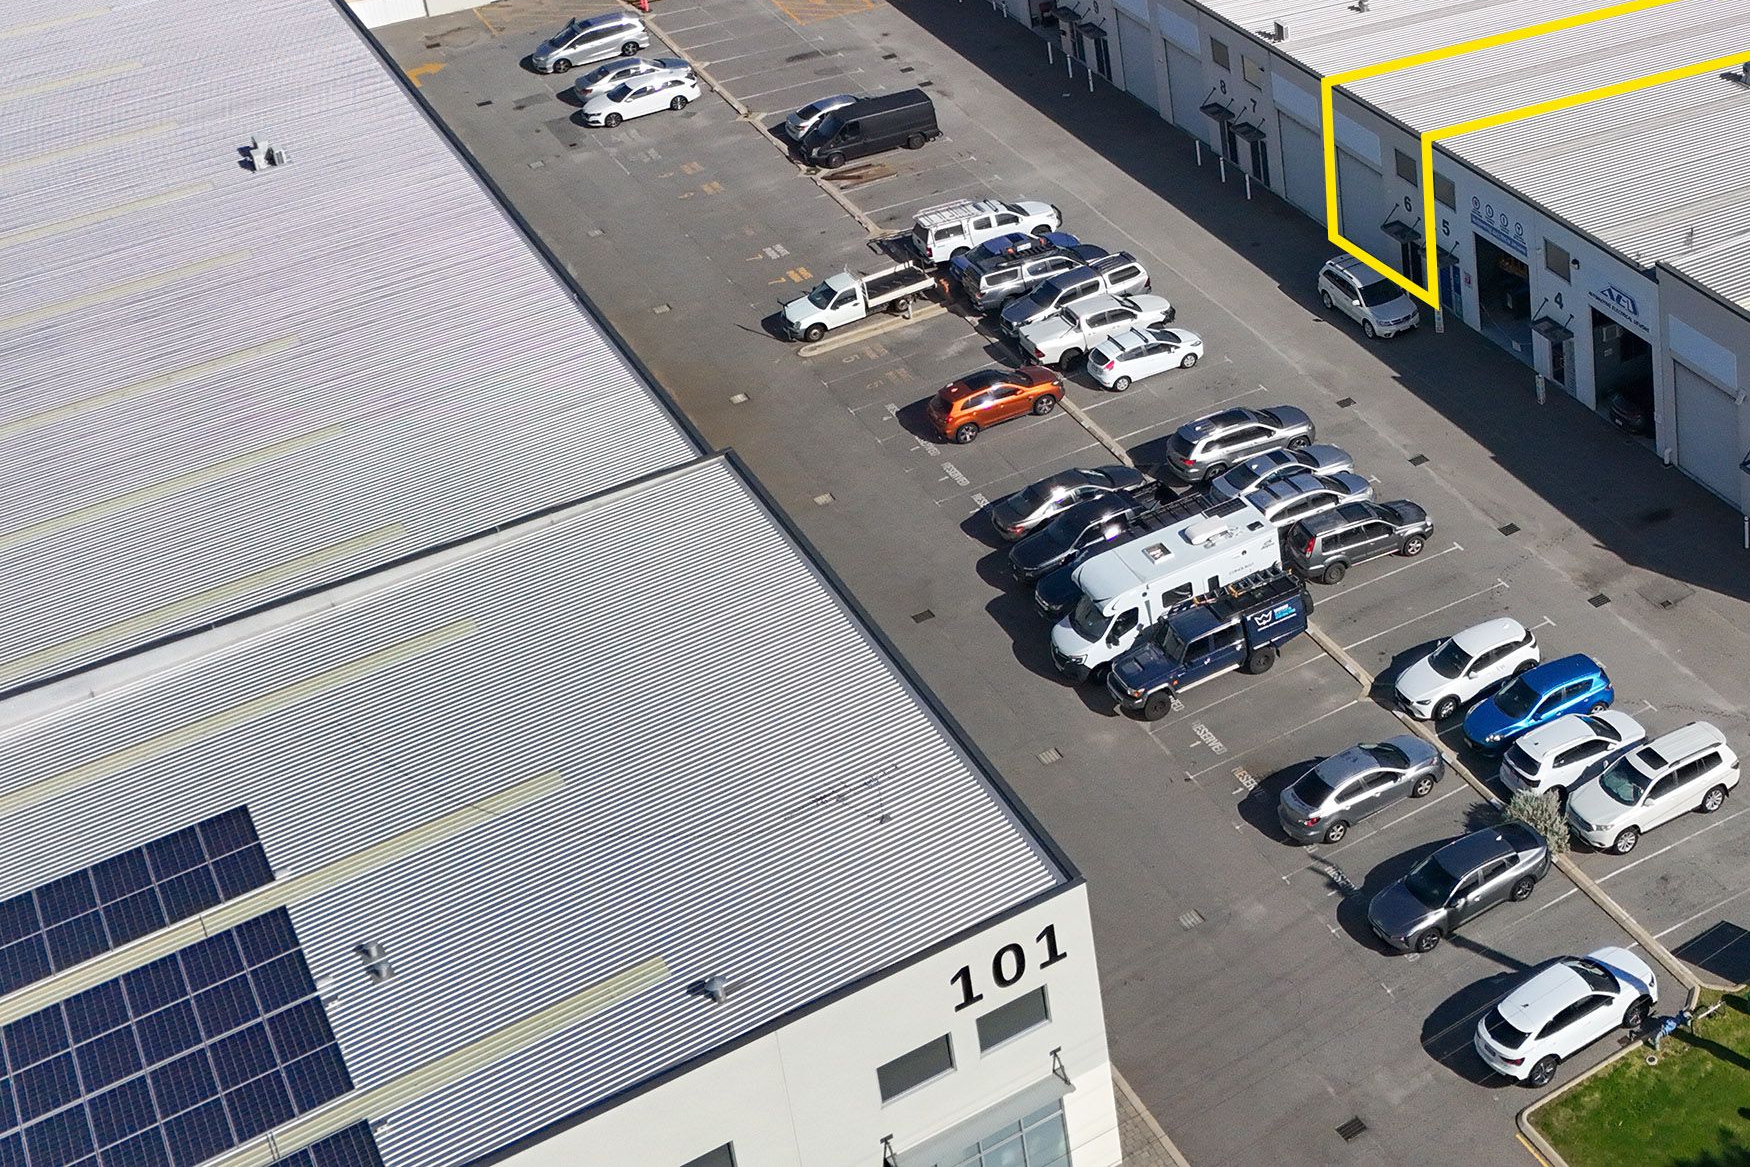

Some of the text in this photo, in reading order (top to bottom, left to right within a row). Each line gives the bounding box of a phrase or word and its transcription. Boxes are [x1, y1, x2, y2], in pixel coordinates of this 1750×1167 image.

[1220, 80, 1226, 94] 8
[1250, 98, 1257, 113] 7
[1404, 196, 1412, 212] 6
[1442, 218, 1450, 236] 5
[1554, 292, 1564, 310] 4
[941, 462, 970, 486] RESERVED
[1192, 719, 1228, 754] RESERVED
[950, 923, 1068, 1012] 101
